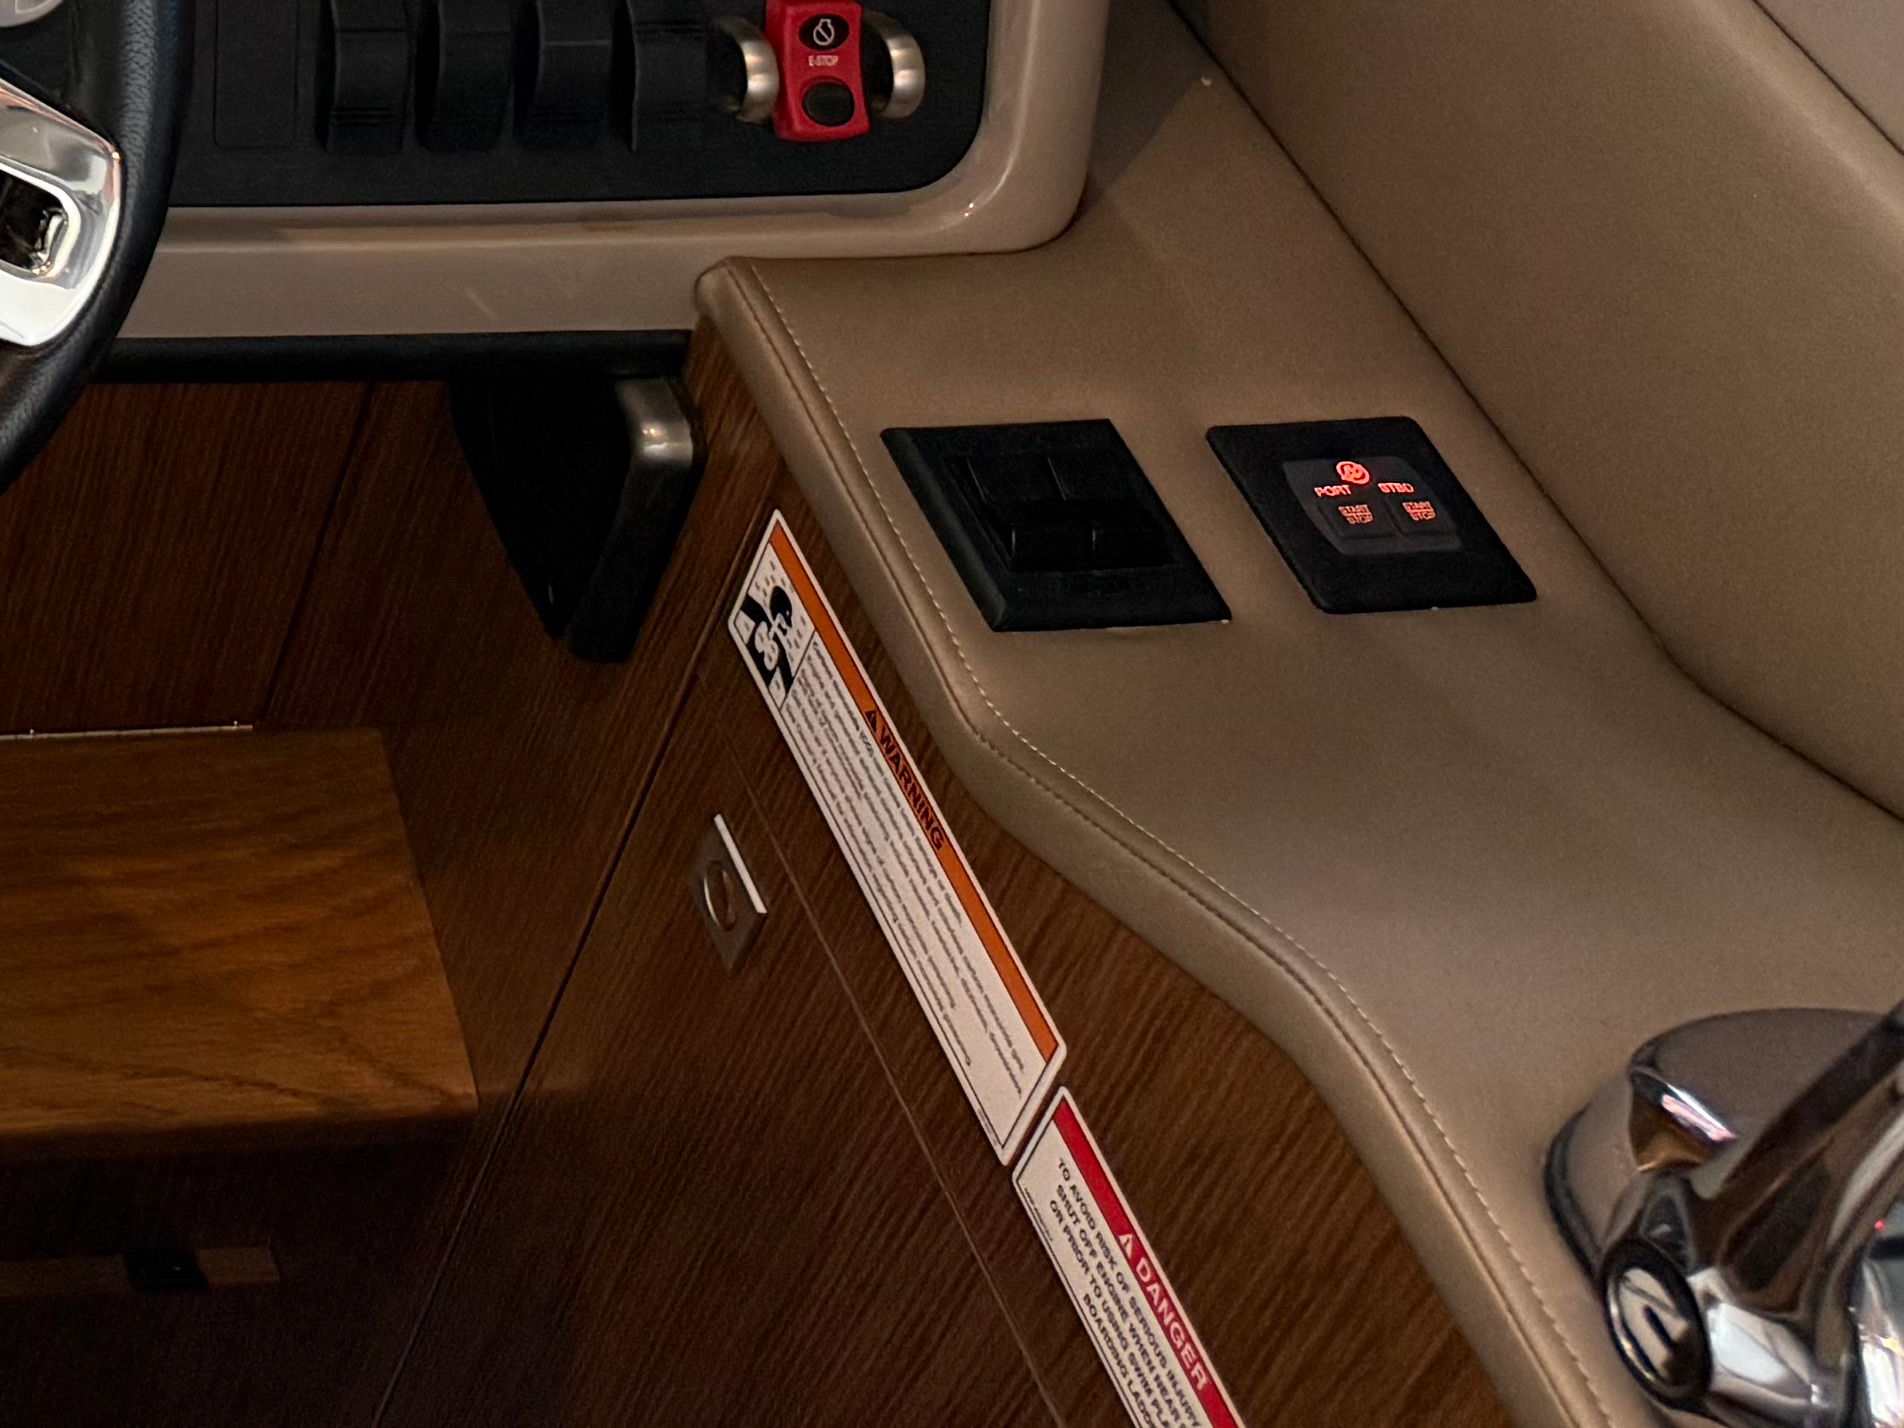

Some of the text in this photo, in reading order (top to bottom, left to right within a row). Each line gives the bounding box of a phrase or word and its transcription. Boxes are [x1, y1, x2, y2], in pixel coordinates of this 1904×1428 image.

[1314, 485, 1351, 497] PORT
[1378, 483, 1414, 493] STBD
[880, 726, 945, 849] WARNING
[1057, 1184, 1081, 1225] SHUT
[1079, 1228, 1097, 1258] OFF
[1096, 1261, 1129, 1322] ENGINE
[1058, 1157, 1070, 1181] TO
[1070, 1184, 1096, 1230] AVOID
[1095, 1232, 1117, 1271] RISK
[1129, 1296, 1167, 1368] SERIOUS
[1136, 1257, 1210, 1391] DANGER
